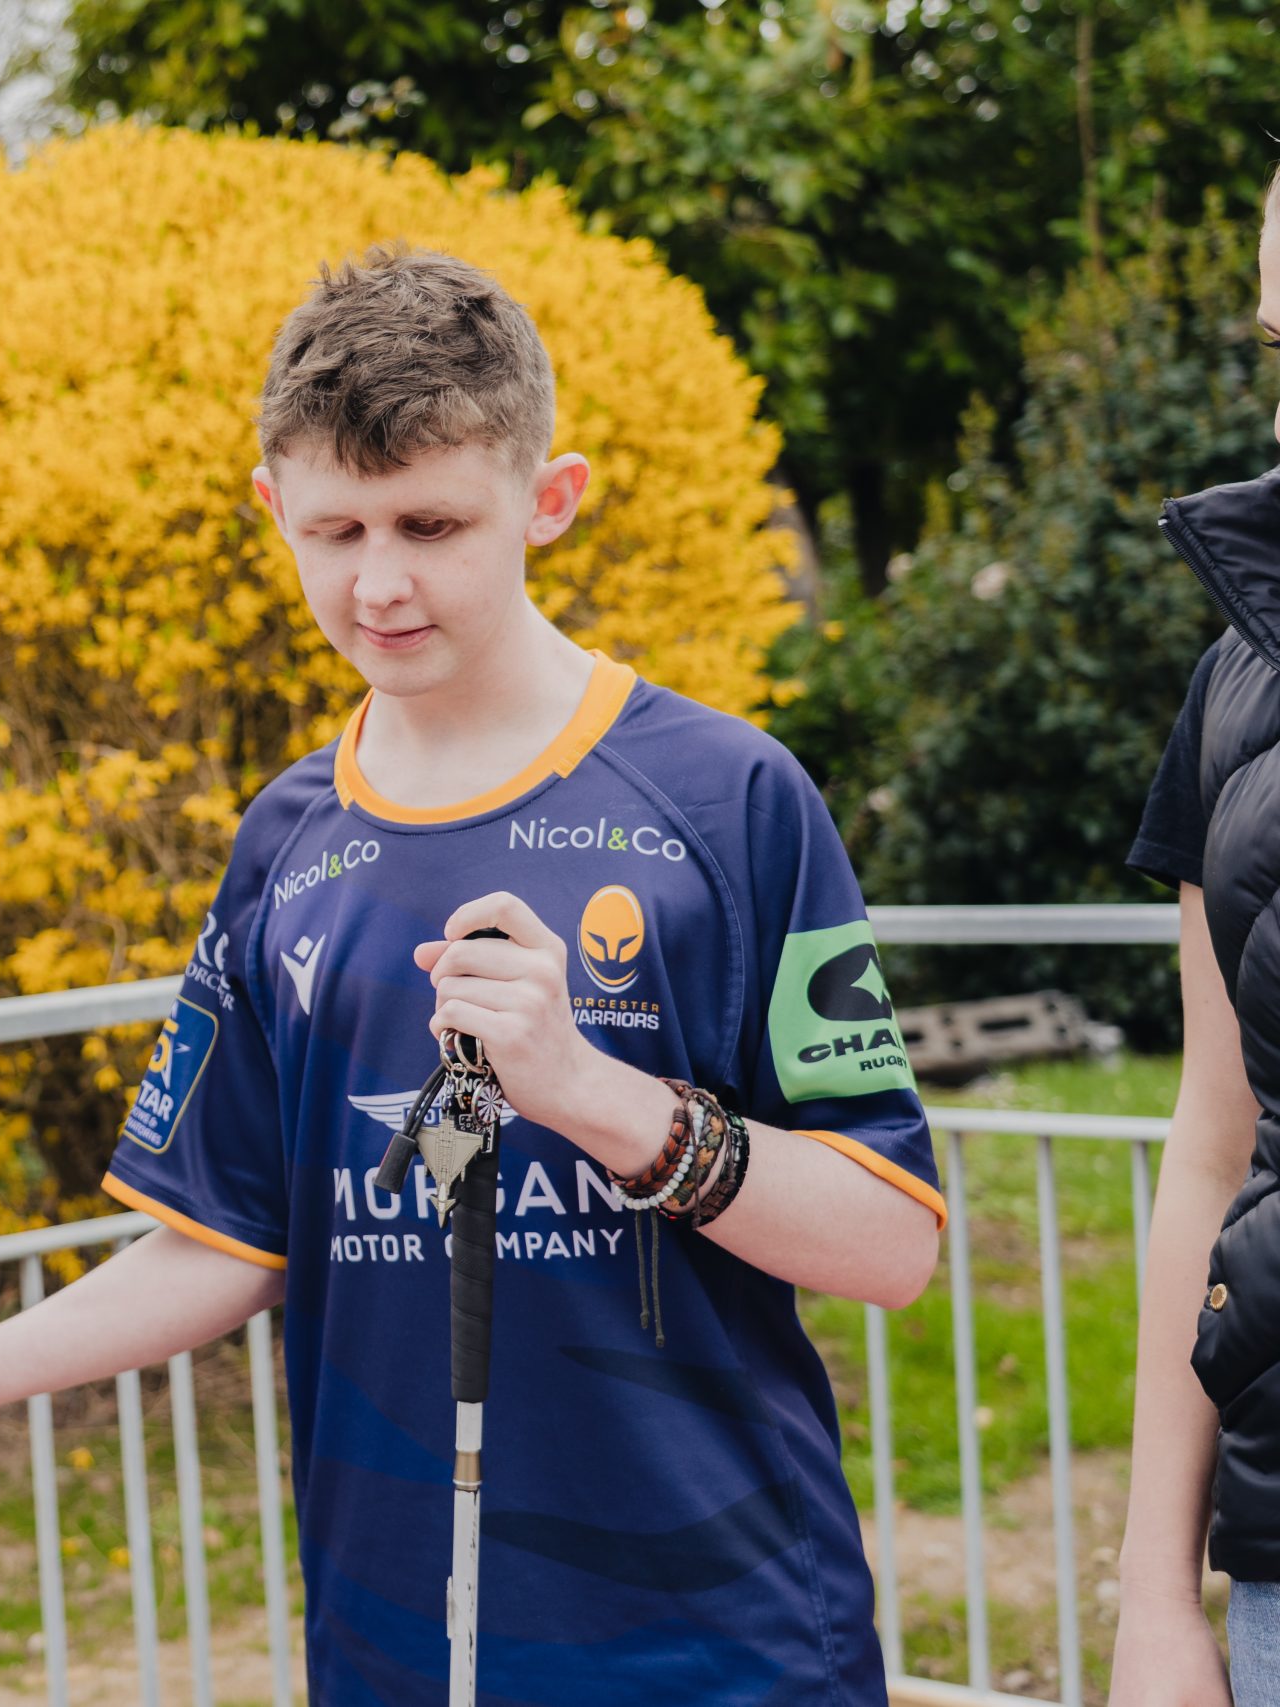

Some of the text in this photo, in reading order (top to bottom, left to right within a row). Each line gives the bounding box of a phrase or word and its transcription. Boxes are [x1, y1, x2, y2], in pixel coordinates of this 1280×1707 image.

[509, 817, 686, 861] Nicol&Co
[274, 839, 380, 909] Nicol&Co
[573, 997, 659, 1013] ORCESTER
[798, 1028, 905, 1063] CHA
[138, 1079, 174, 1122] TAR
[330, 1234, 425, 1262] MOTOR
